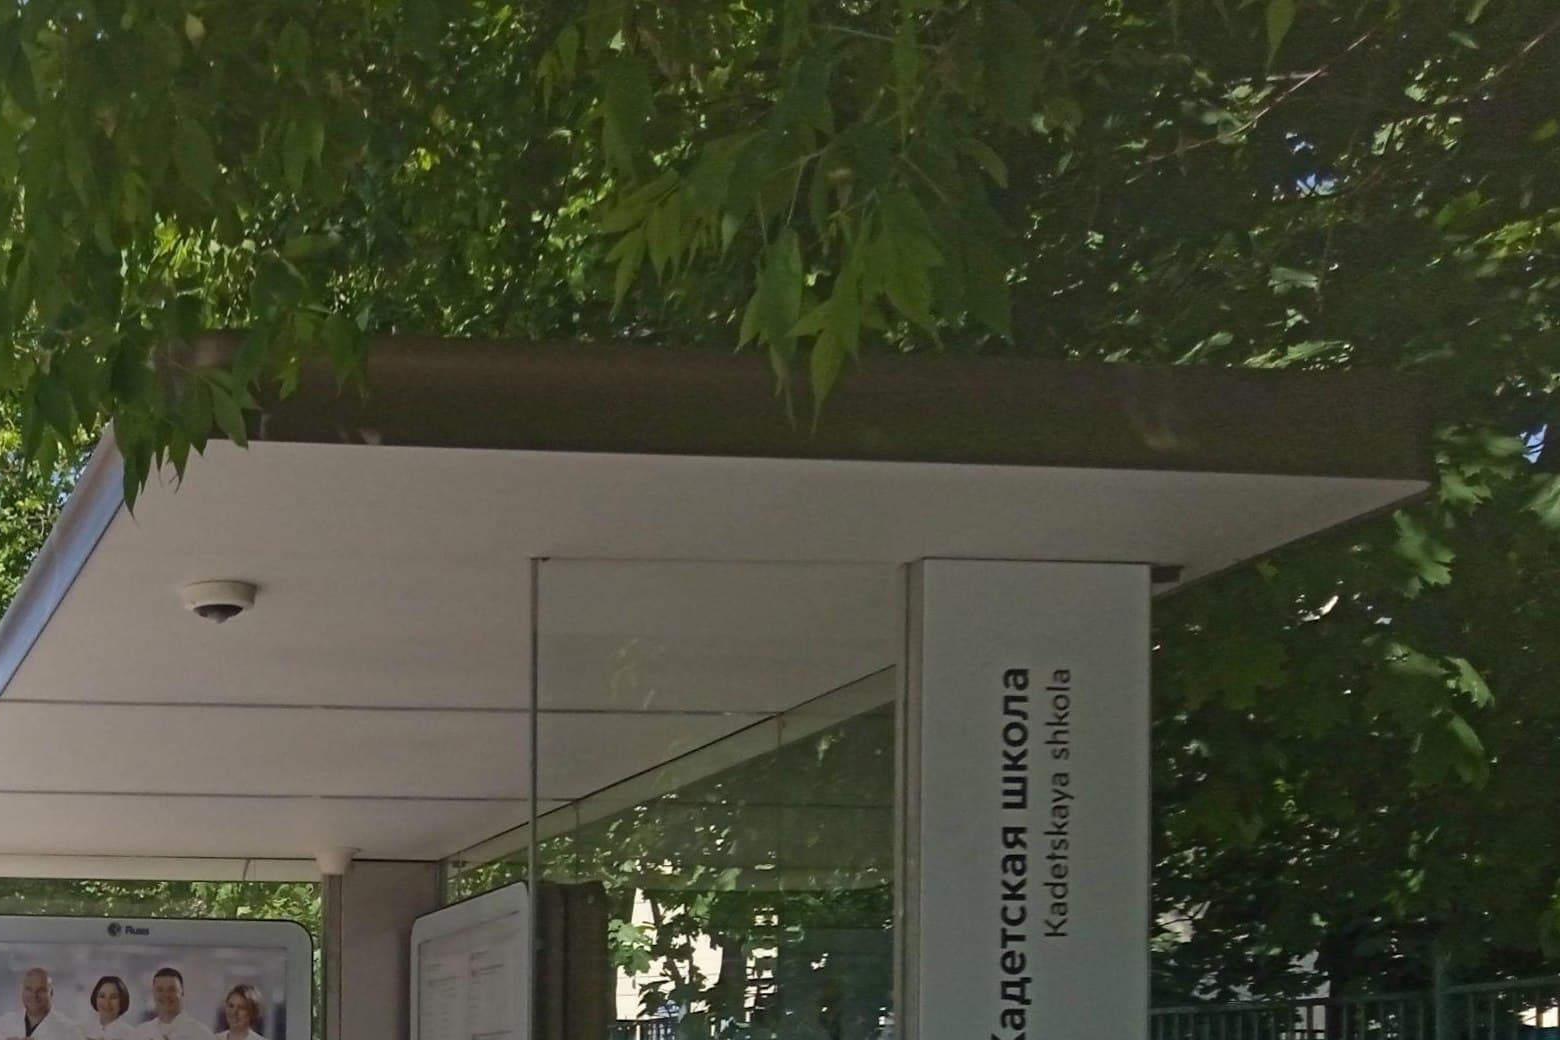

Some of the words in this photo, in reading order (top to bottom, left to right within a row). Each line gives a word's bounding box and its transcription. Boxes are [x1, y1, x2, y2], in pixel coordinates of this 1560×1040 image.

[1001, 667, 1030, 810] школа
[1045, 668, 1071, 760] shkola
[1044, 772, 1074, 937] Kadetskaya
